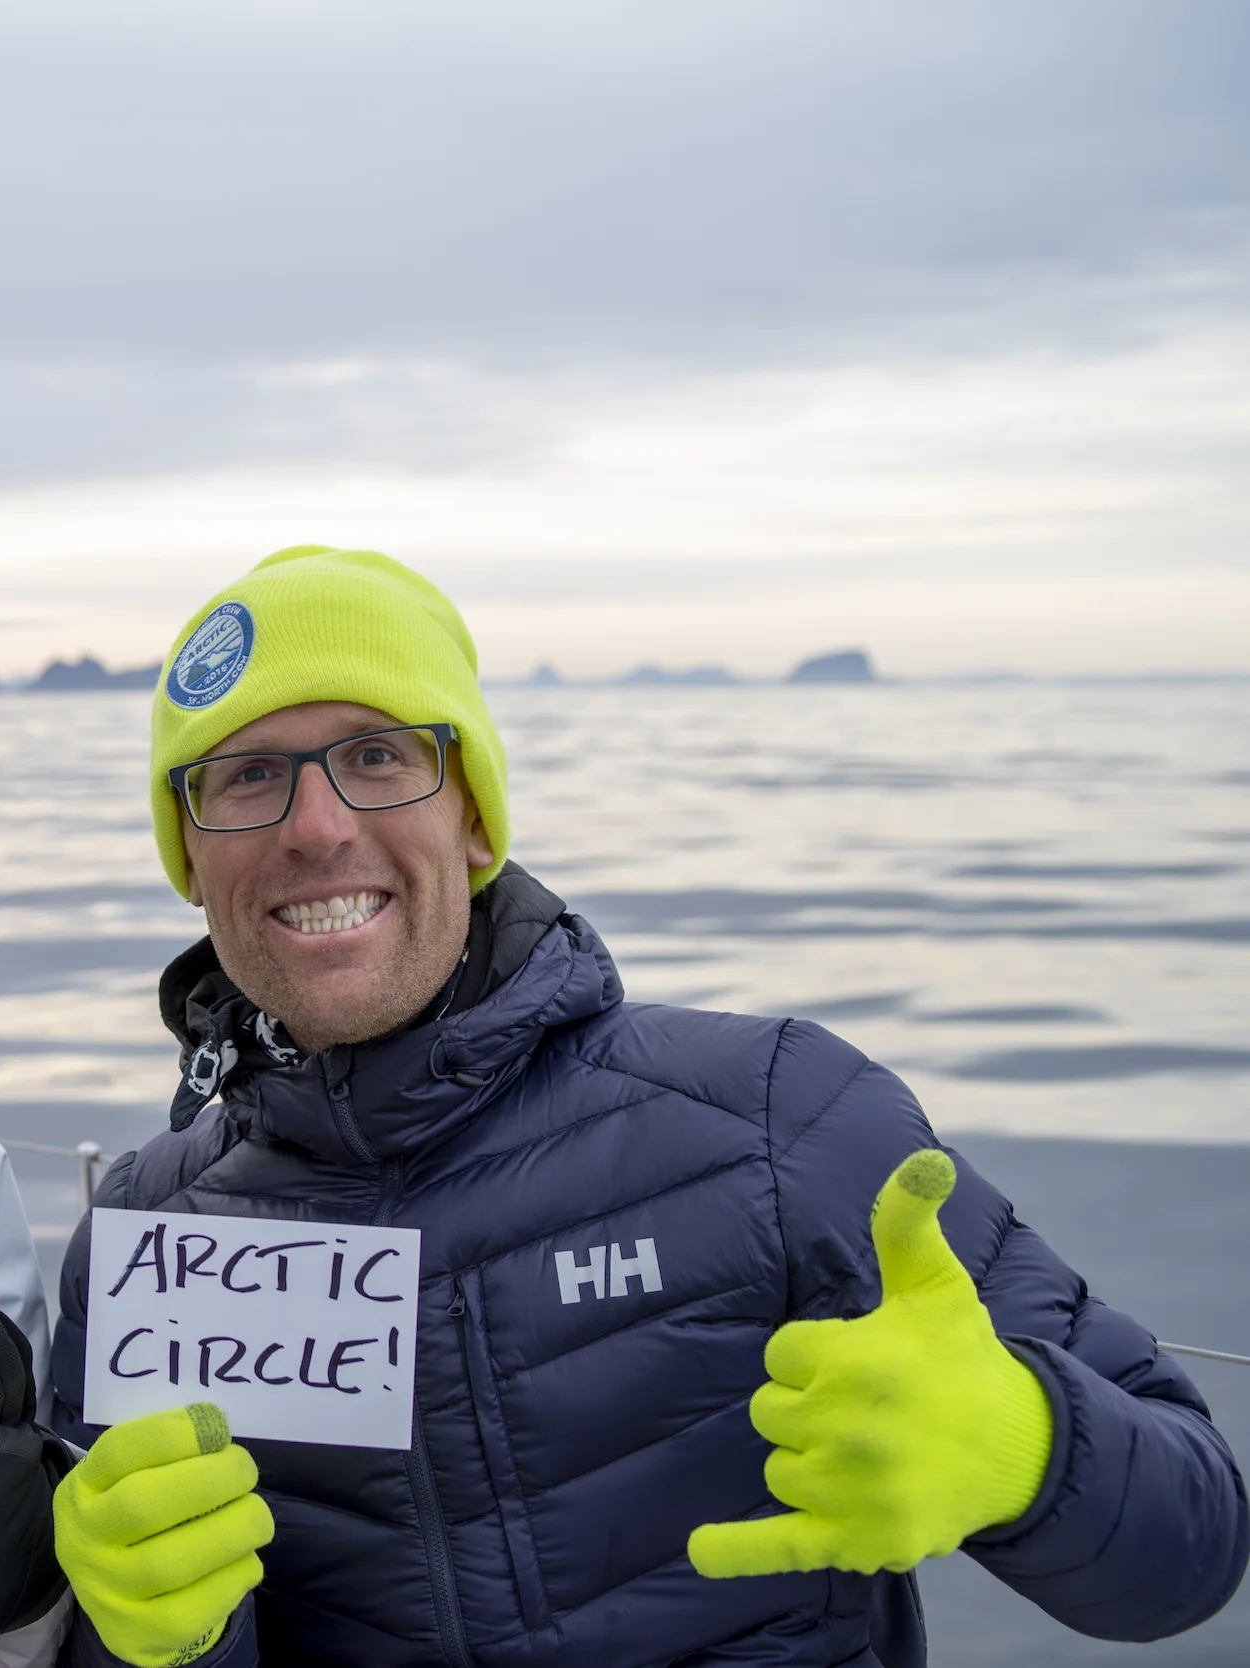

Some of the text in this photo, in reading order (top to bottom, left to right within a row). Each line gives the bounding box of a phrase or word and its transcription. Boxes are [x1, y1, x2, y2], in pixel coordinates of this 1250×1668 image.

[221, 604, 243, 616] CREW
[187, 621, 228, 662] ARCTIC
[554, 1237, 664, 1305] HH
